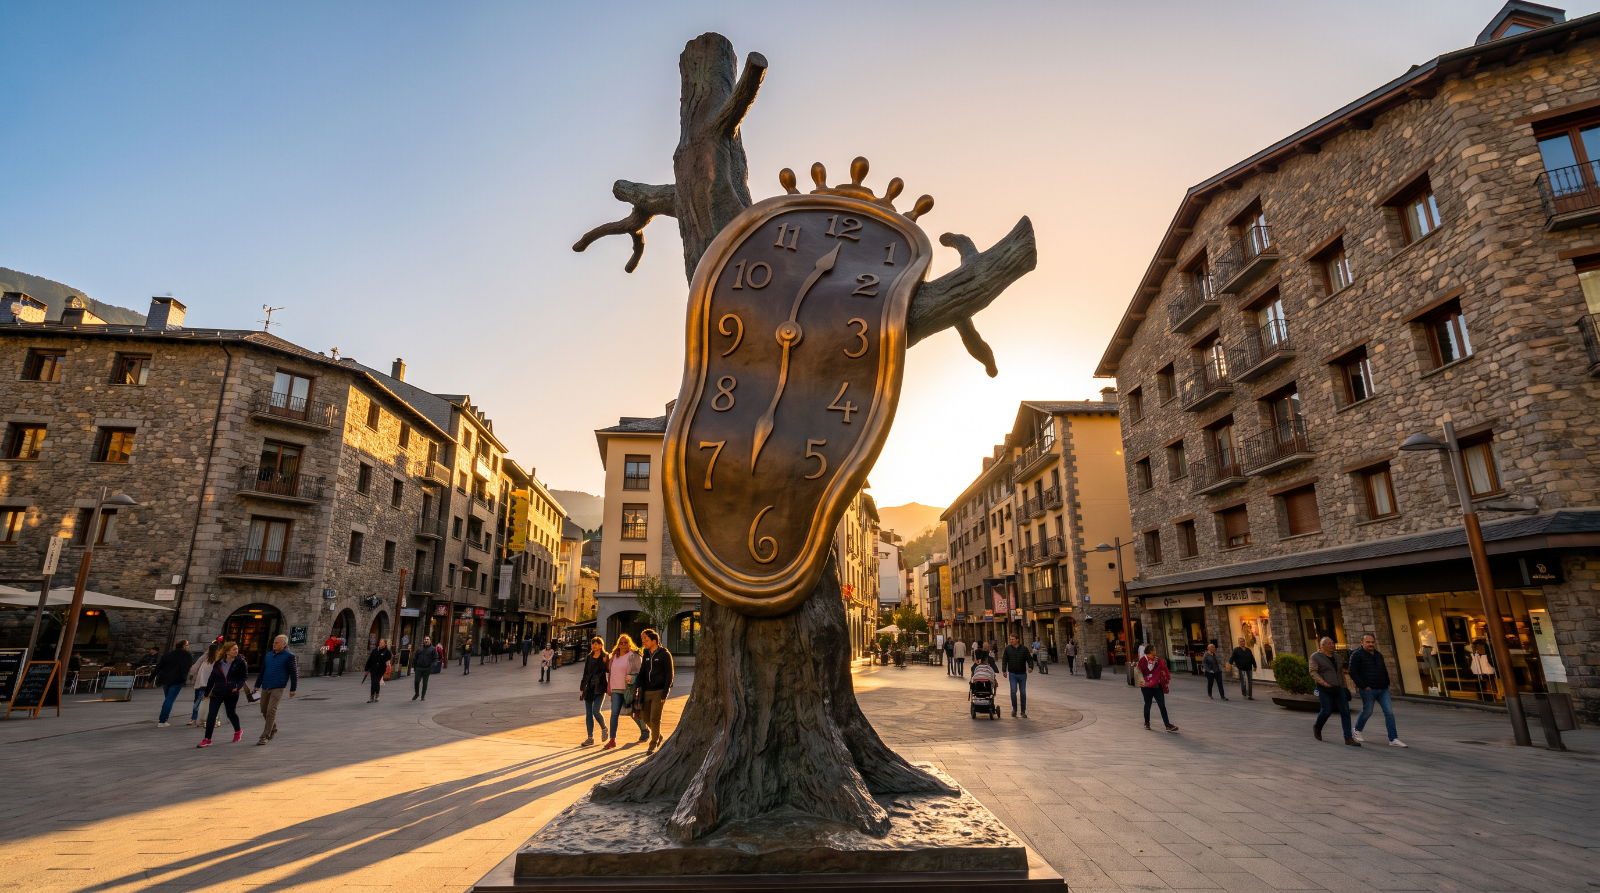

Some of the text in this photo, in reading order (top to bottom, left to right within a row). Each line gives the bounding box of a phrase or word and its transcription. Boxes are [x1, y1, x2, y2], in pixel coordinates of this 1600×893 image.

[774, 222, 802, 251] 11
[825, 215, 864, 242] 12
[884, 242, 897, 265] 1
[732, 259, 773, 290] 10
[852, 273, 880, 297] 2
[718, 314, 744, 357] 9
[843, 318, 869, 359] 3
[710, 376, 737, 412] 8
[827, 382, 859, 424] 4
[699, 441, 726, 490] 7
[804, 438, 828, 480] 5
[748, 505, 779, 564] 6
